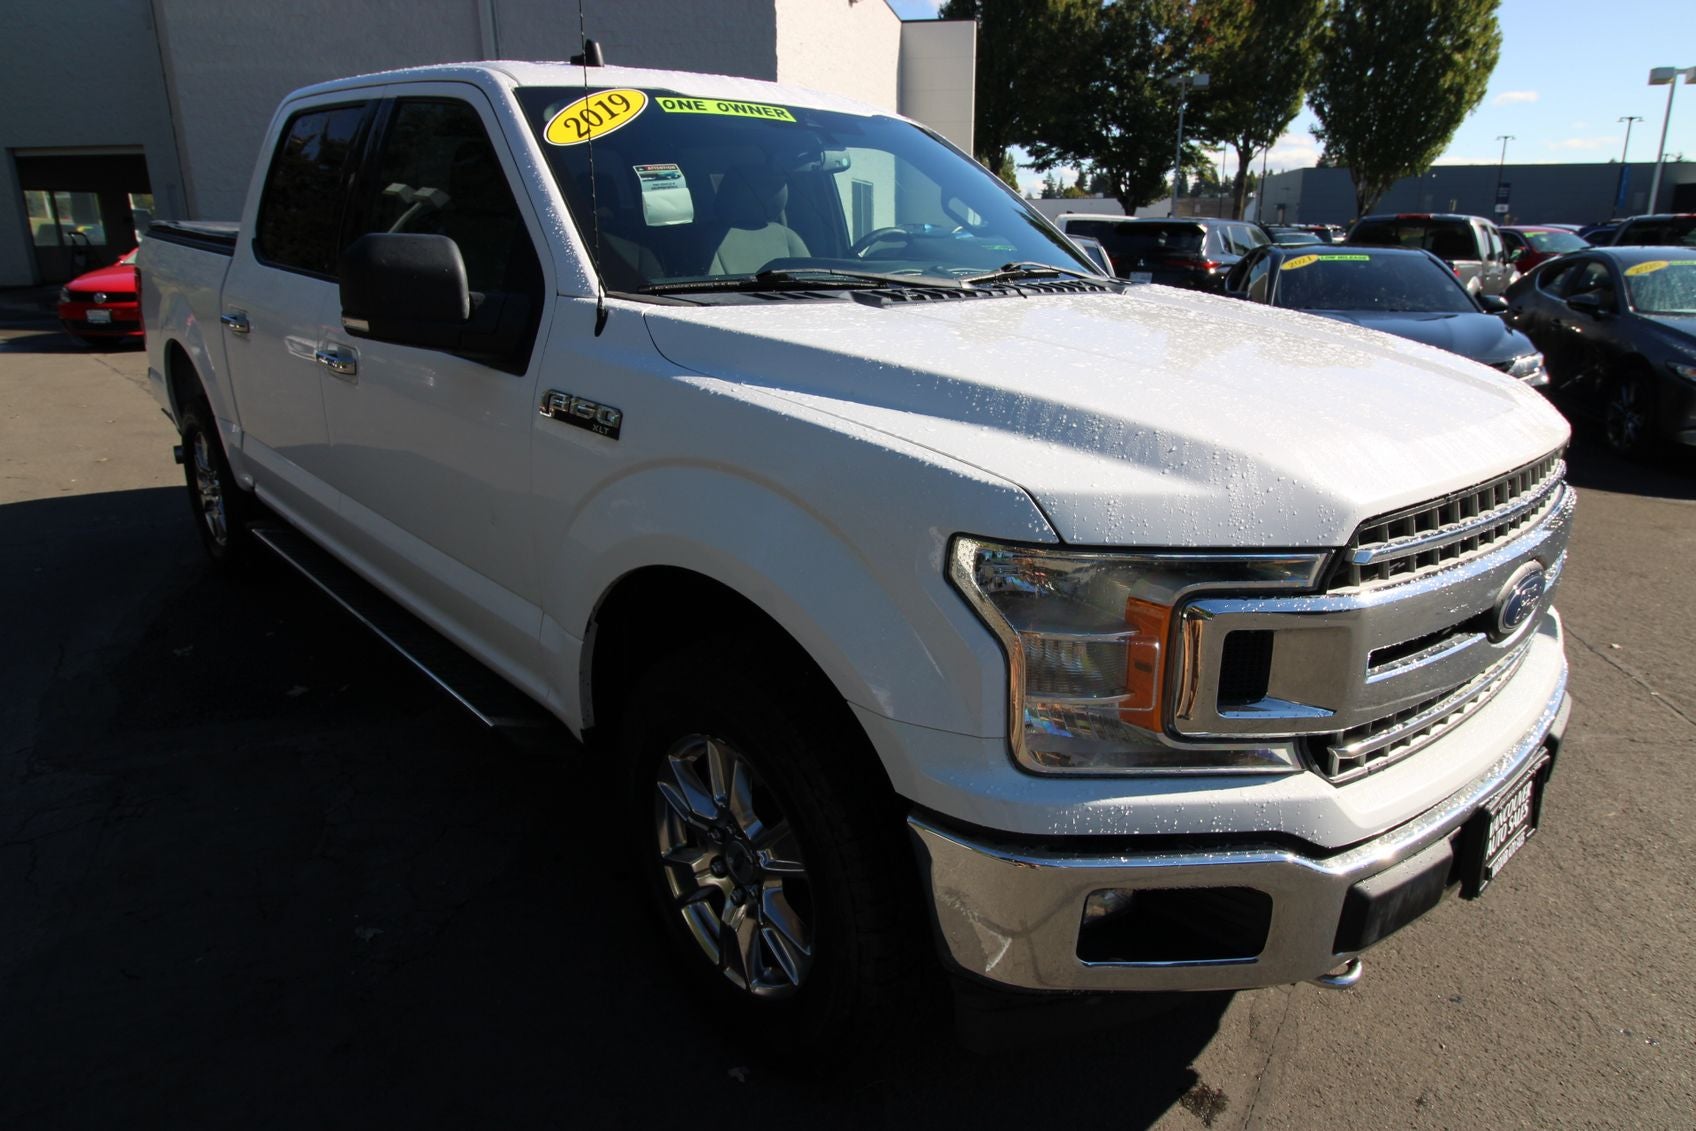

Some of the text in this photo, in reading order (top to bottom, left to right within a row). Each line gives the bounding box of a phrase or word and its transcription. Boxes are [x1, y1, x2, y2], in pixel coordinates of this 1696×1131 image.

[563, 92, 631, 139] 2019
[662, 99, 790, 119] ONE OWNER
[592, 424, 609, 435] XLT
